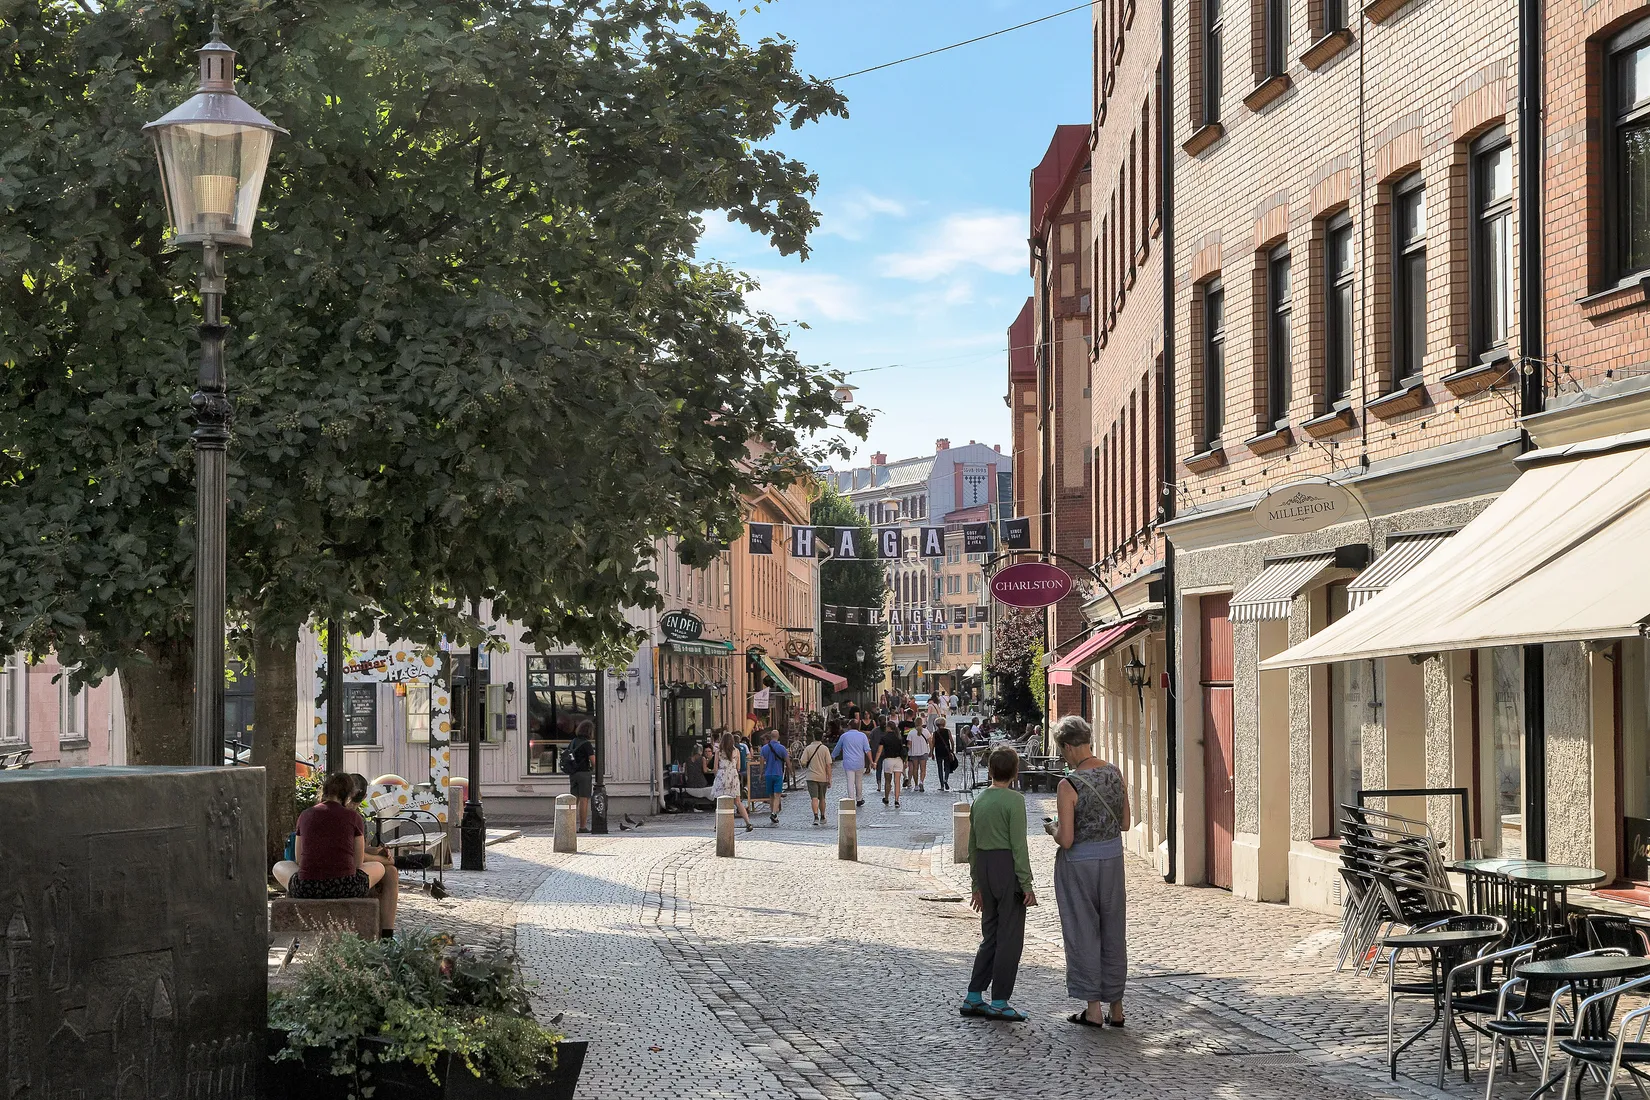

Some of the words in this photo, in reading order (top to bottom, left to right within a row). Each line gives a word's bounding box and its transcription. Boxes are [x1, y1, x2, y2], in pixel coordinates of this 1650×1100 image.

[1268, 501, 1335, 521] MILLEFIORI
[797, 529, 942, 557] HAGA
[995, 580, 1063, 591] CHARLSTON
[666, 616, 679, 628] EN
[870, 609, 943, 624] HAGA
[343, 659, 386, 674] ommar
[388, 666, 428, 681] HAGA
